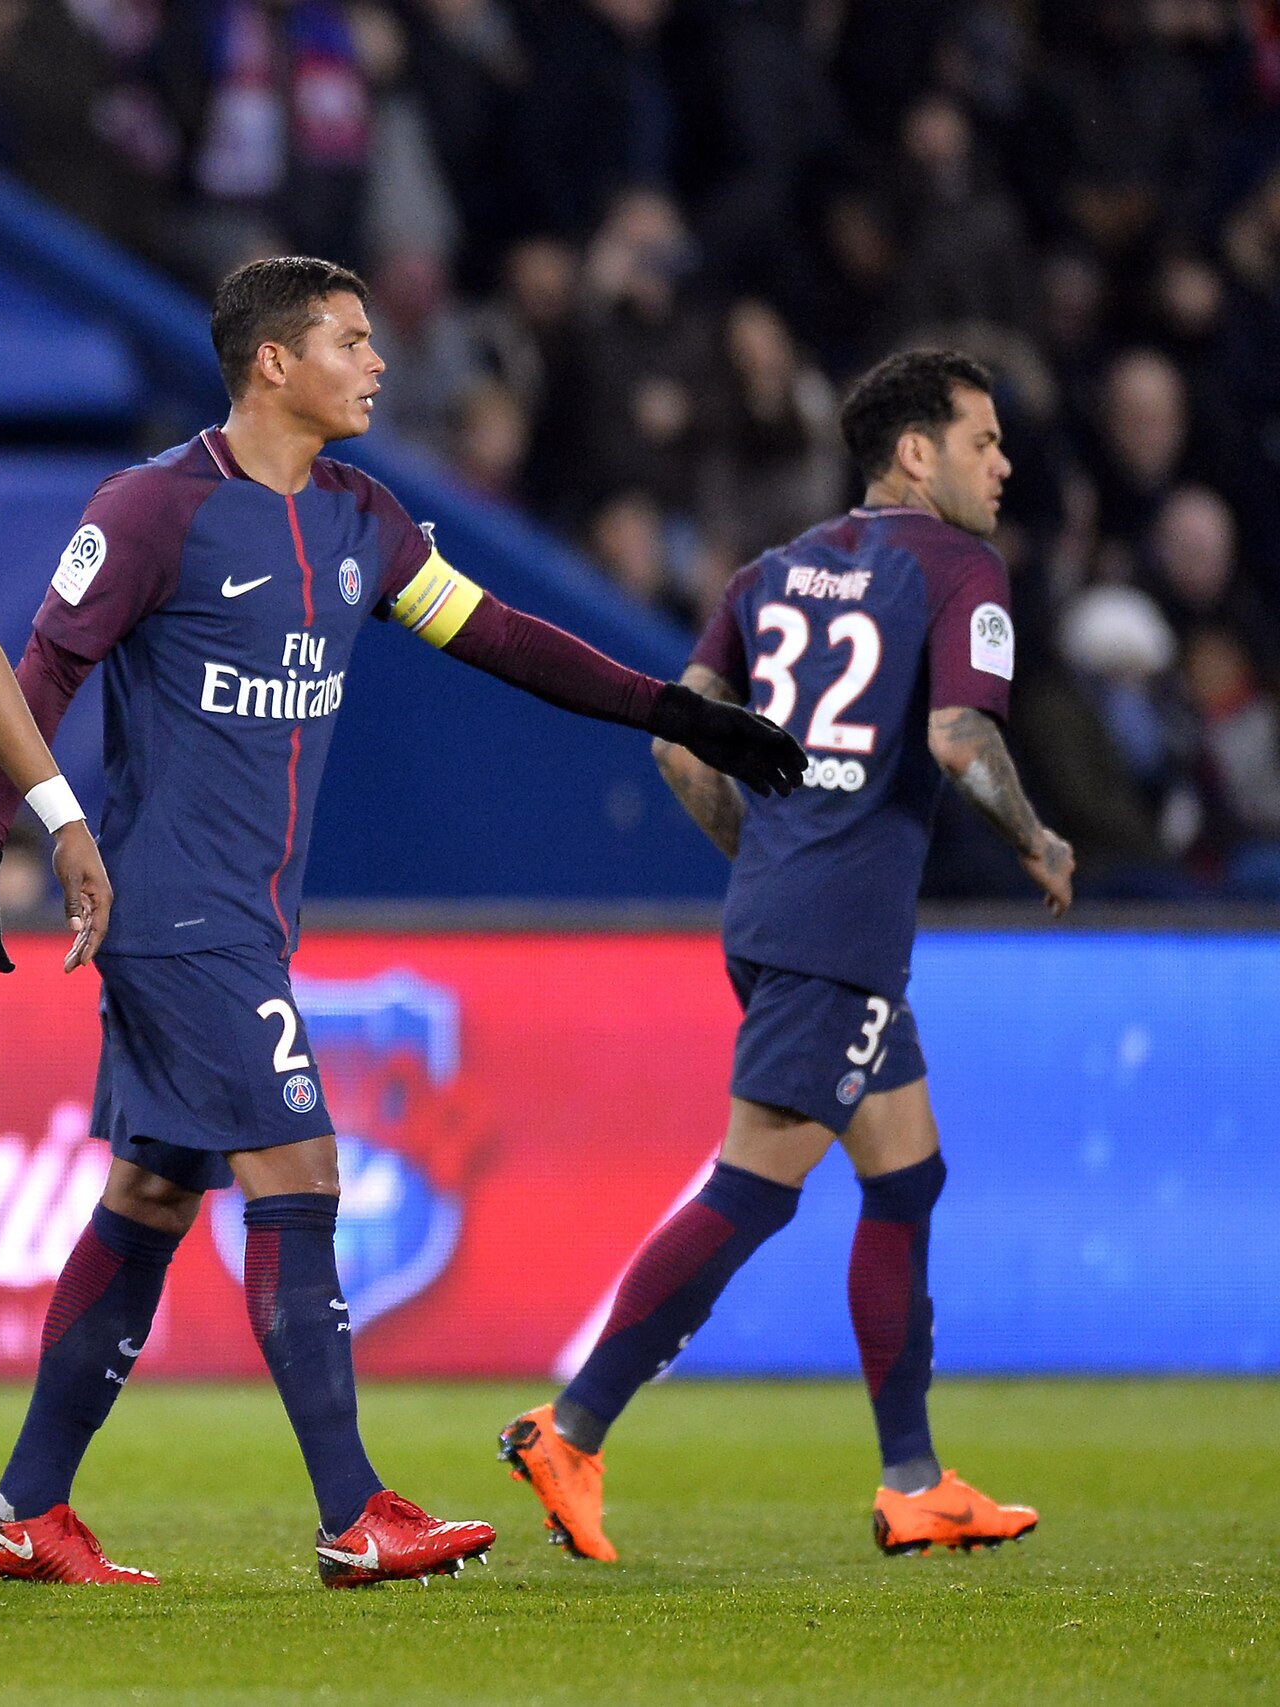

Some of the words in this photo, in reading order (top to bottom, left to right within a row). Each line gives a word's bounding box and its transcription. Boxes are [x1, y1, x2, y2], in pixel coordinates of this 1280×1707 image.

[282, 633, 325, 672] Fly
[753, 603, 881, 753] 32
[200, 662, 345, 719] Emirates
[256, 999, 310, 1072] 2
[846, 996, 896, 1074] 3
[287, 1078, 309, 1088] PARIS
